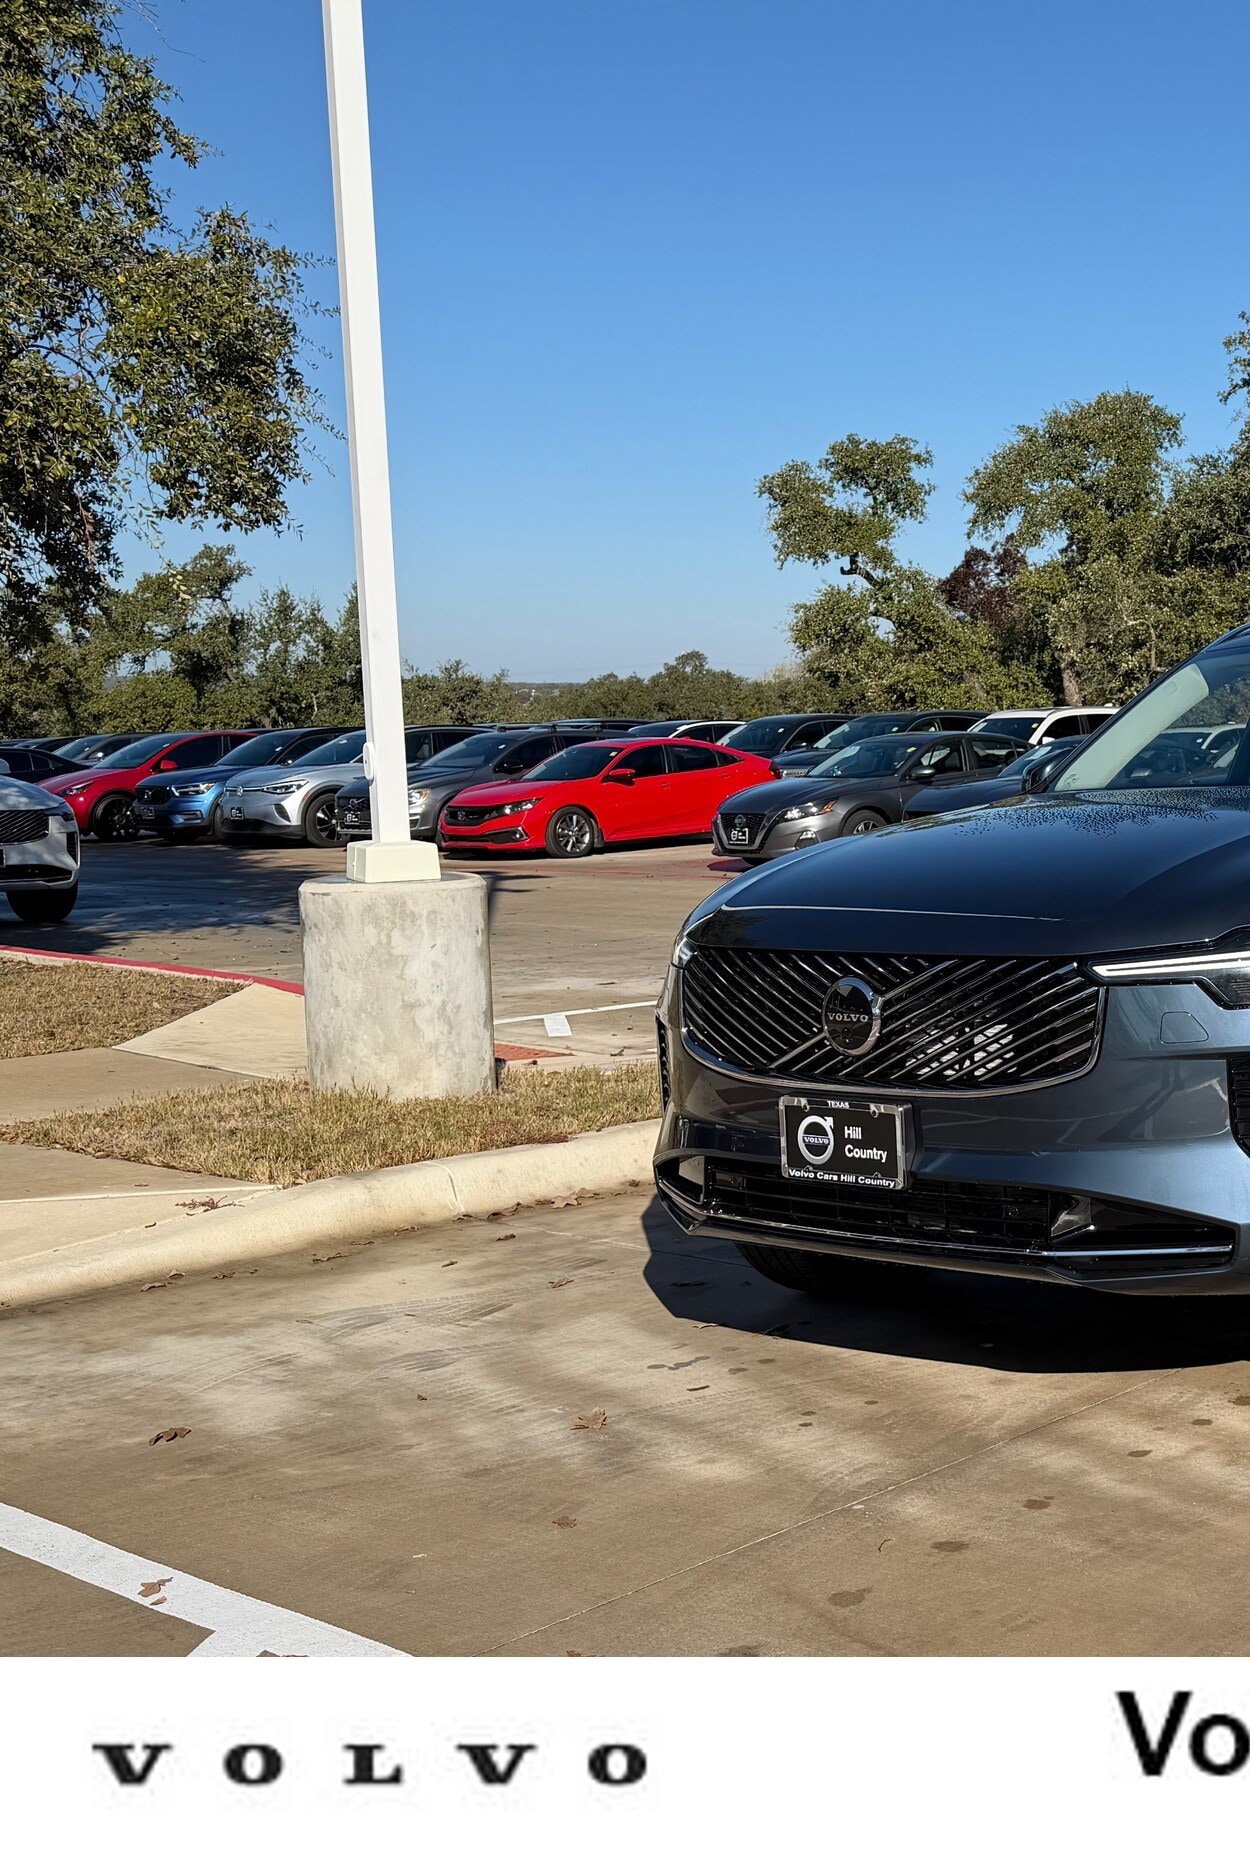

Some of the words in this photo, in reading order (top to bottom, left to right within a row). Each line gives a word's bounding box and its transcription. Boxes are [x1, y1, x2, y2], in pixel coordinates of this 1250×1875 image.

[827, 1012, 869, 1022] VOLVO
[827, 1100, 850, 1109] TEXAS
[844, 1126, 862, 1140] Hill
[803, 1136, 829, 1144] VOLVO
[844, 1144, 887, 1163] Country
[788, 1168, 815, 1179] Volvo
[816, 1171, 839, 1181] Cars
[840, 1174, 856, 1183] Hill
[858, 1176, 895, 1188] Country
